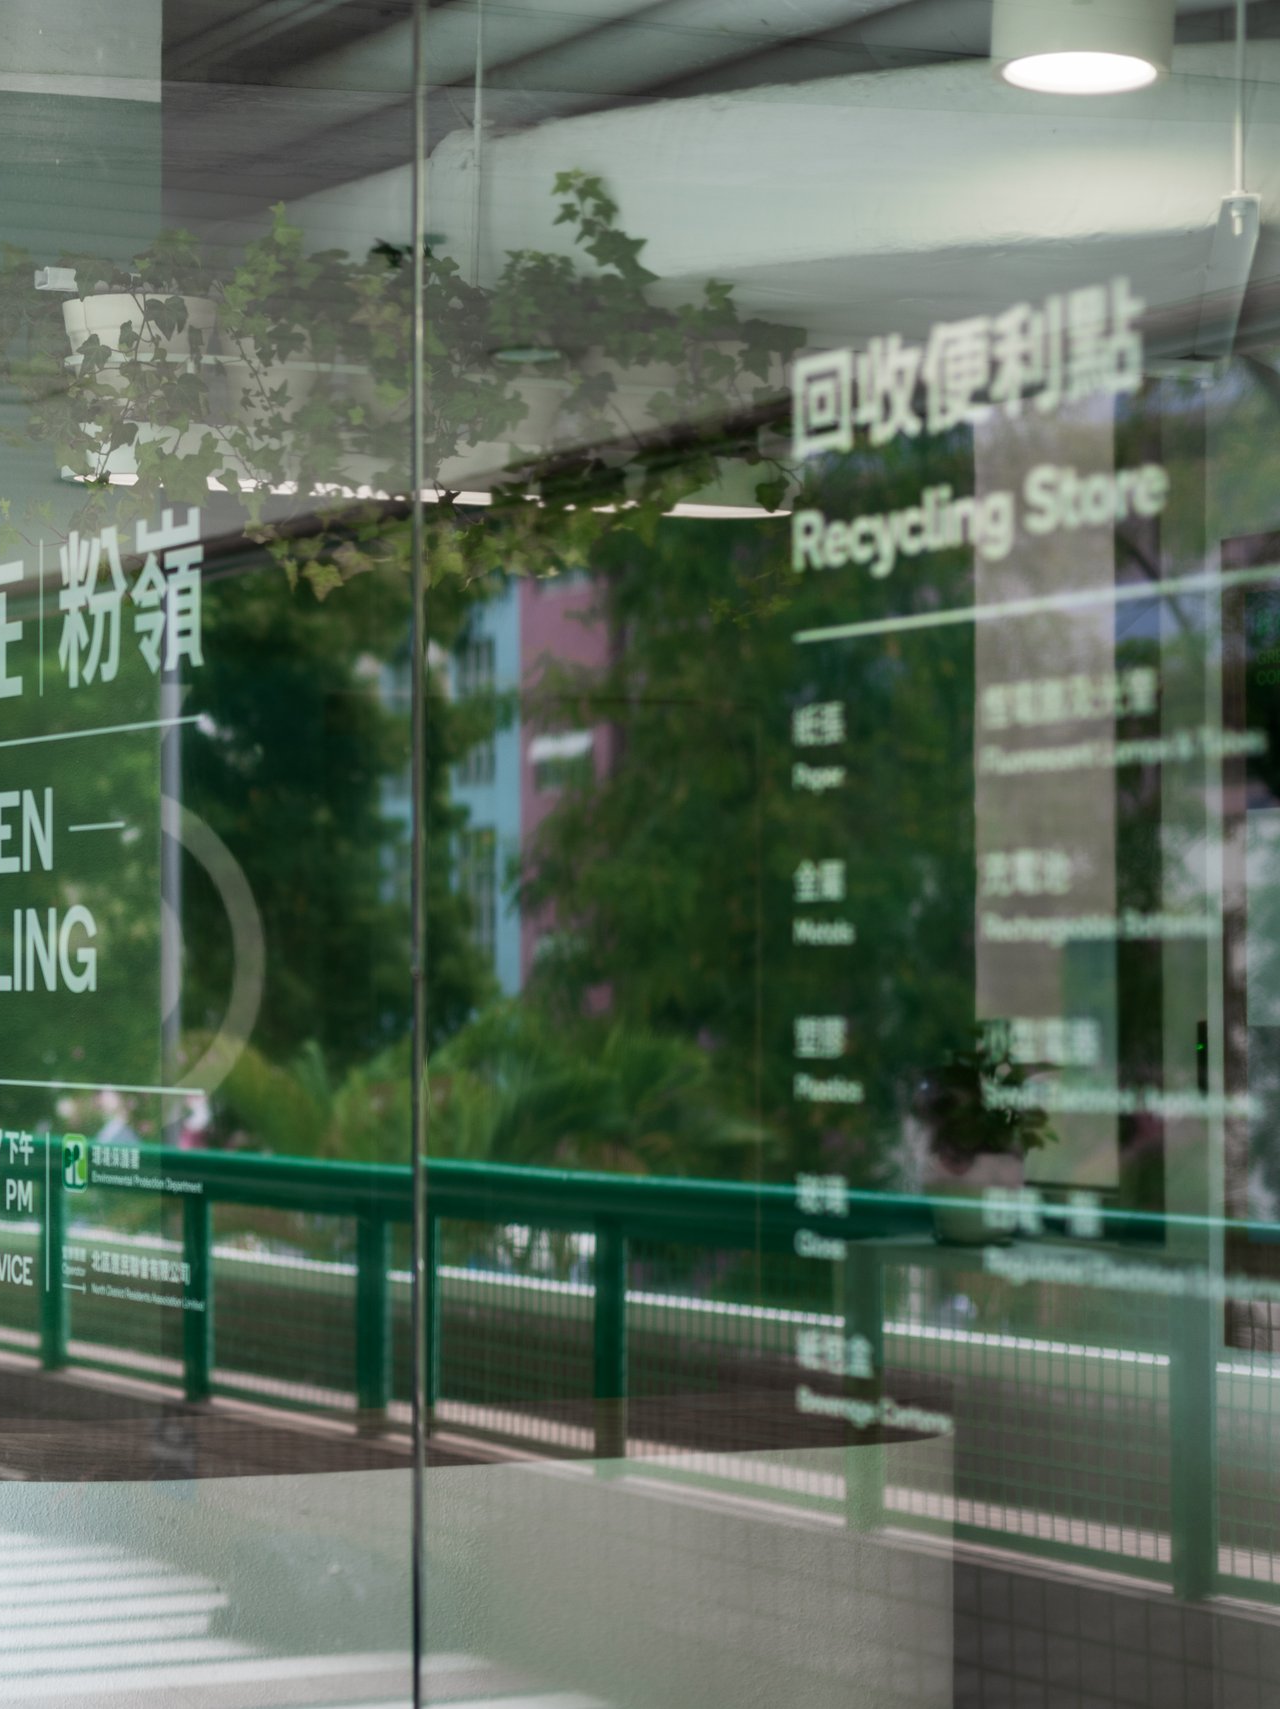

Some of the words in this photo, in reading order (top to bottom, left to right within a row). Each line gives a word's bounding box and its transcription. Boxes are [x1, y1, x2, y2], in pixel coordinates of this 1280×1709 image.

[791, 276, 1145, 462] 回收便利點
[792, 482, 1016, 578] Recycling
[1023, 464, 1169, 536] Store
[58, 506, 205, 689] 粉嶺
[5, 1130, 34, 1166] 下午
[6, 1178, 33, 1213] PM
